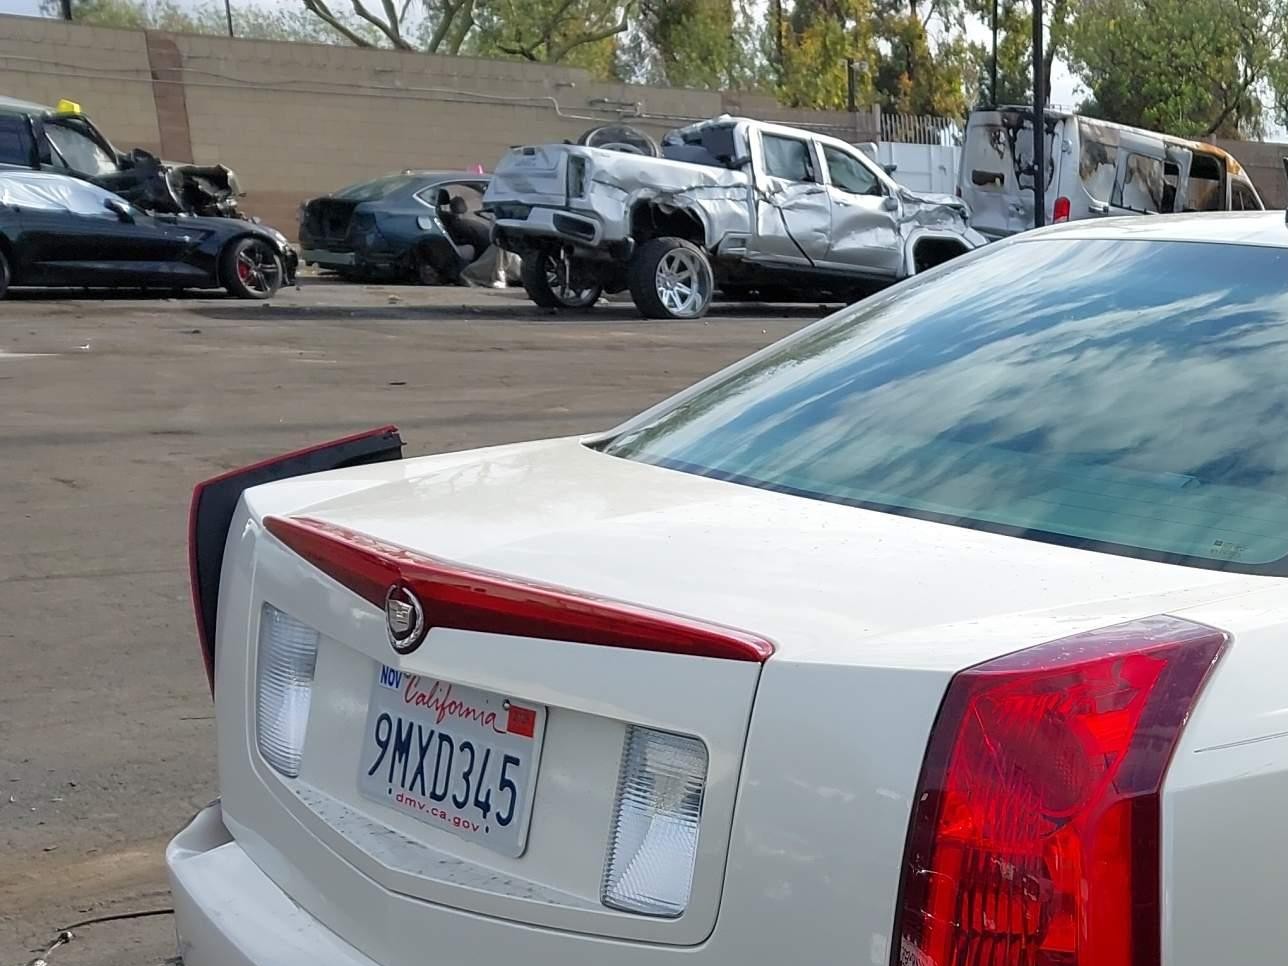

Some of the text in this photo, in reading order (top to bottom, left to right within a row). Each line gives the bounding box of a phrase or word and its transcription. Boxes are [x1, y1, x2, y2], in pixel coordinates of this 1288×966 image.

[380, 664, 402, 689] NOV
[403, 675, 507, 734] California
[367, 711, 521, 827] 9MXD345
[395, 791, 480, 833] dmv.ca.gov
